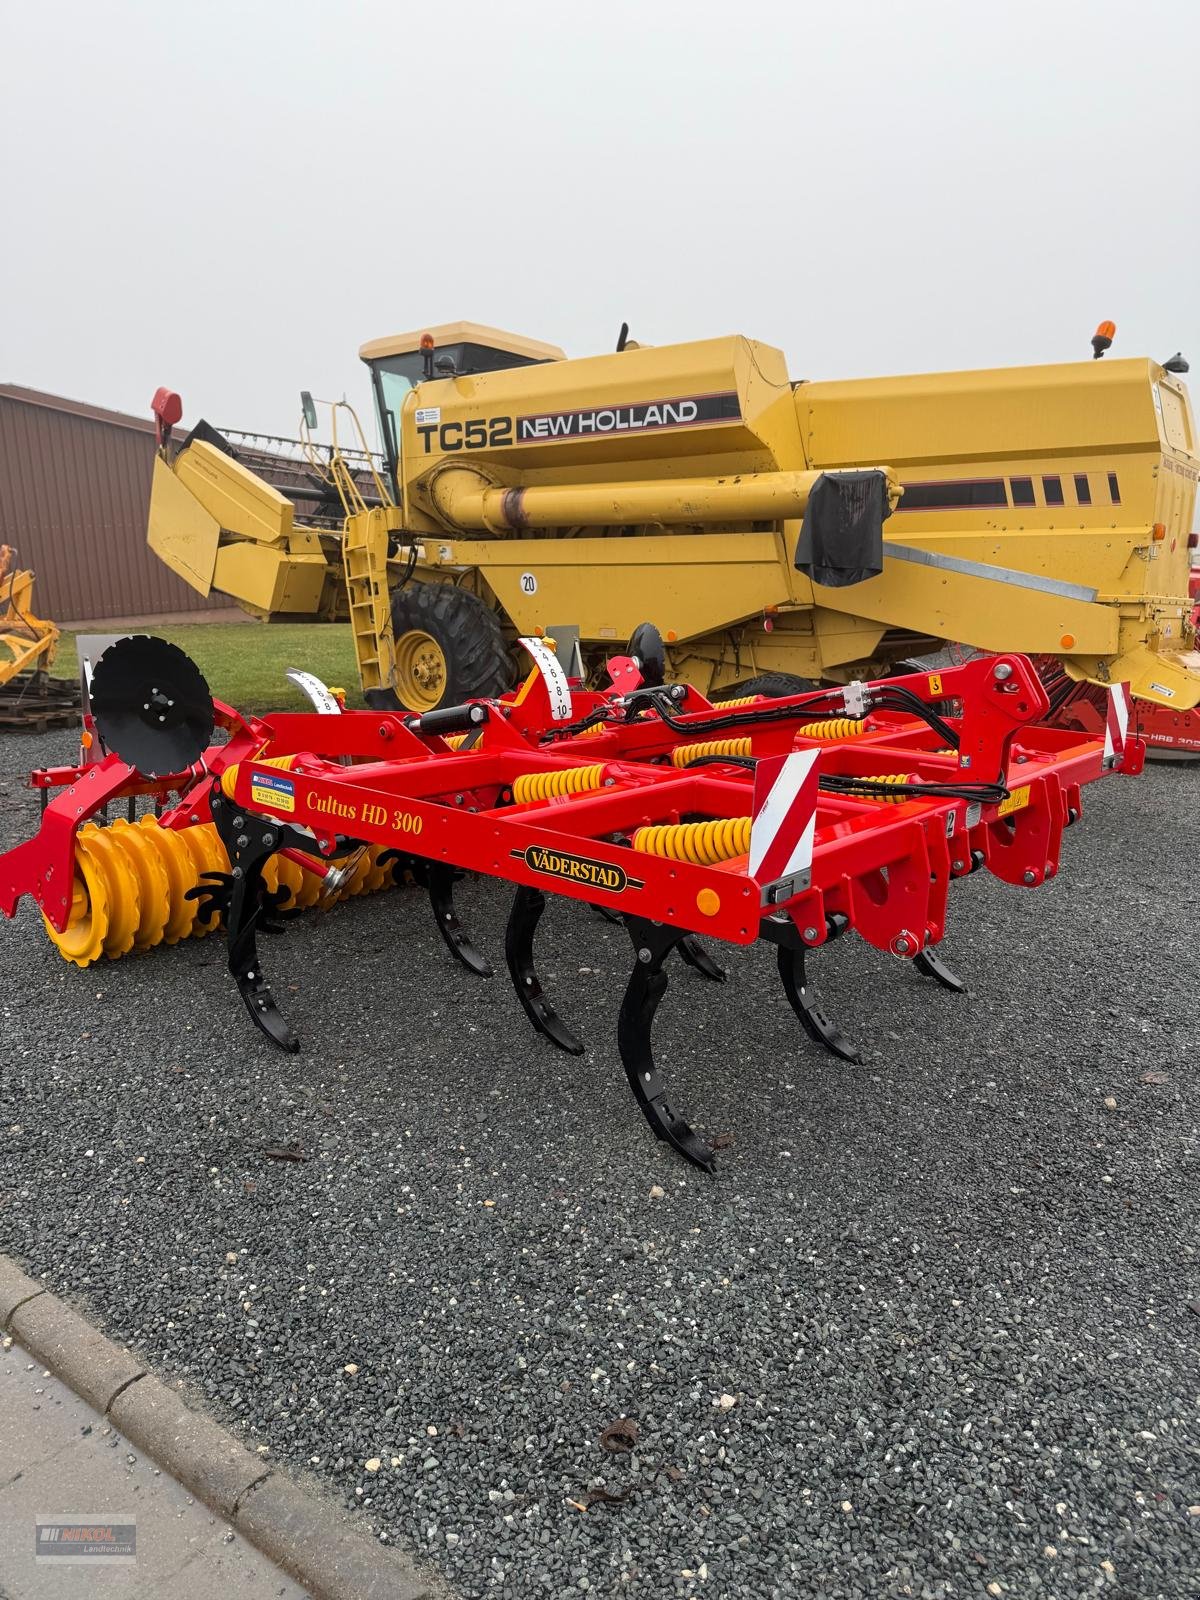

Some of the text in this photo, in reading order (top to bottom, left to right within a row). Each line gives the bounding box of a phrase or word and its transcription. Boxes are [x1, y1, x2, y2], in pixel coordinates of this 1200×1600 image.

[522, 400, 698, 439] NEW HOLLAND
[416, 415, 513, 454] TC52
[523, 576, 535, 592] 20
[550, 668, 557, 678] 6
[556, 686, 562, 696] 8
[324, 702, 331, 711] 8
[557, 705, 567, 715] 10
[306, 791, 357, 820] Cultus
[361, 803, 388, 826] HD
[392, 811, 423, 835] 300
[947, 812, 954, 833] 2
[531, 849, 620, 887] VÄDERSTAD
